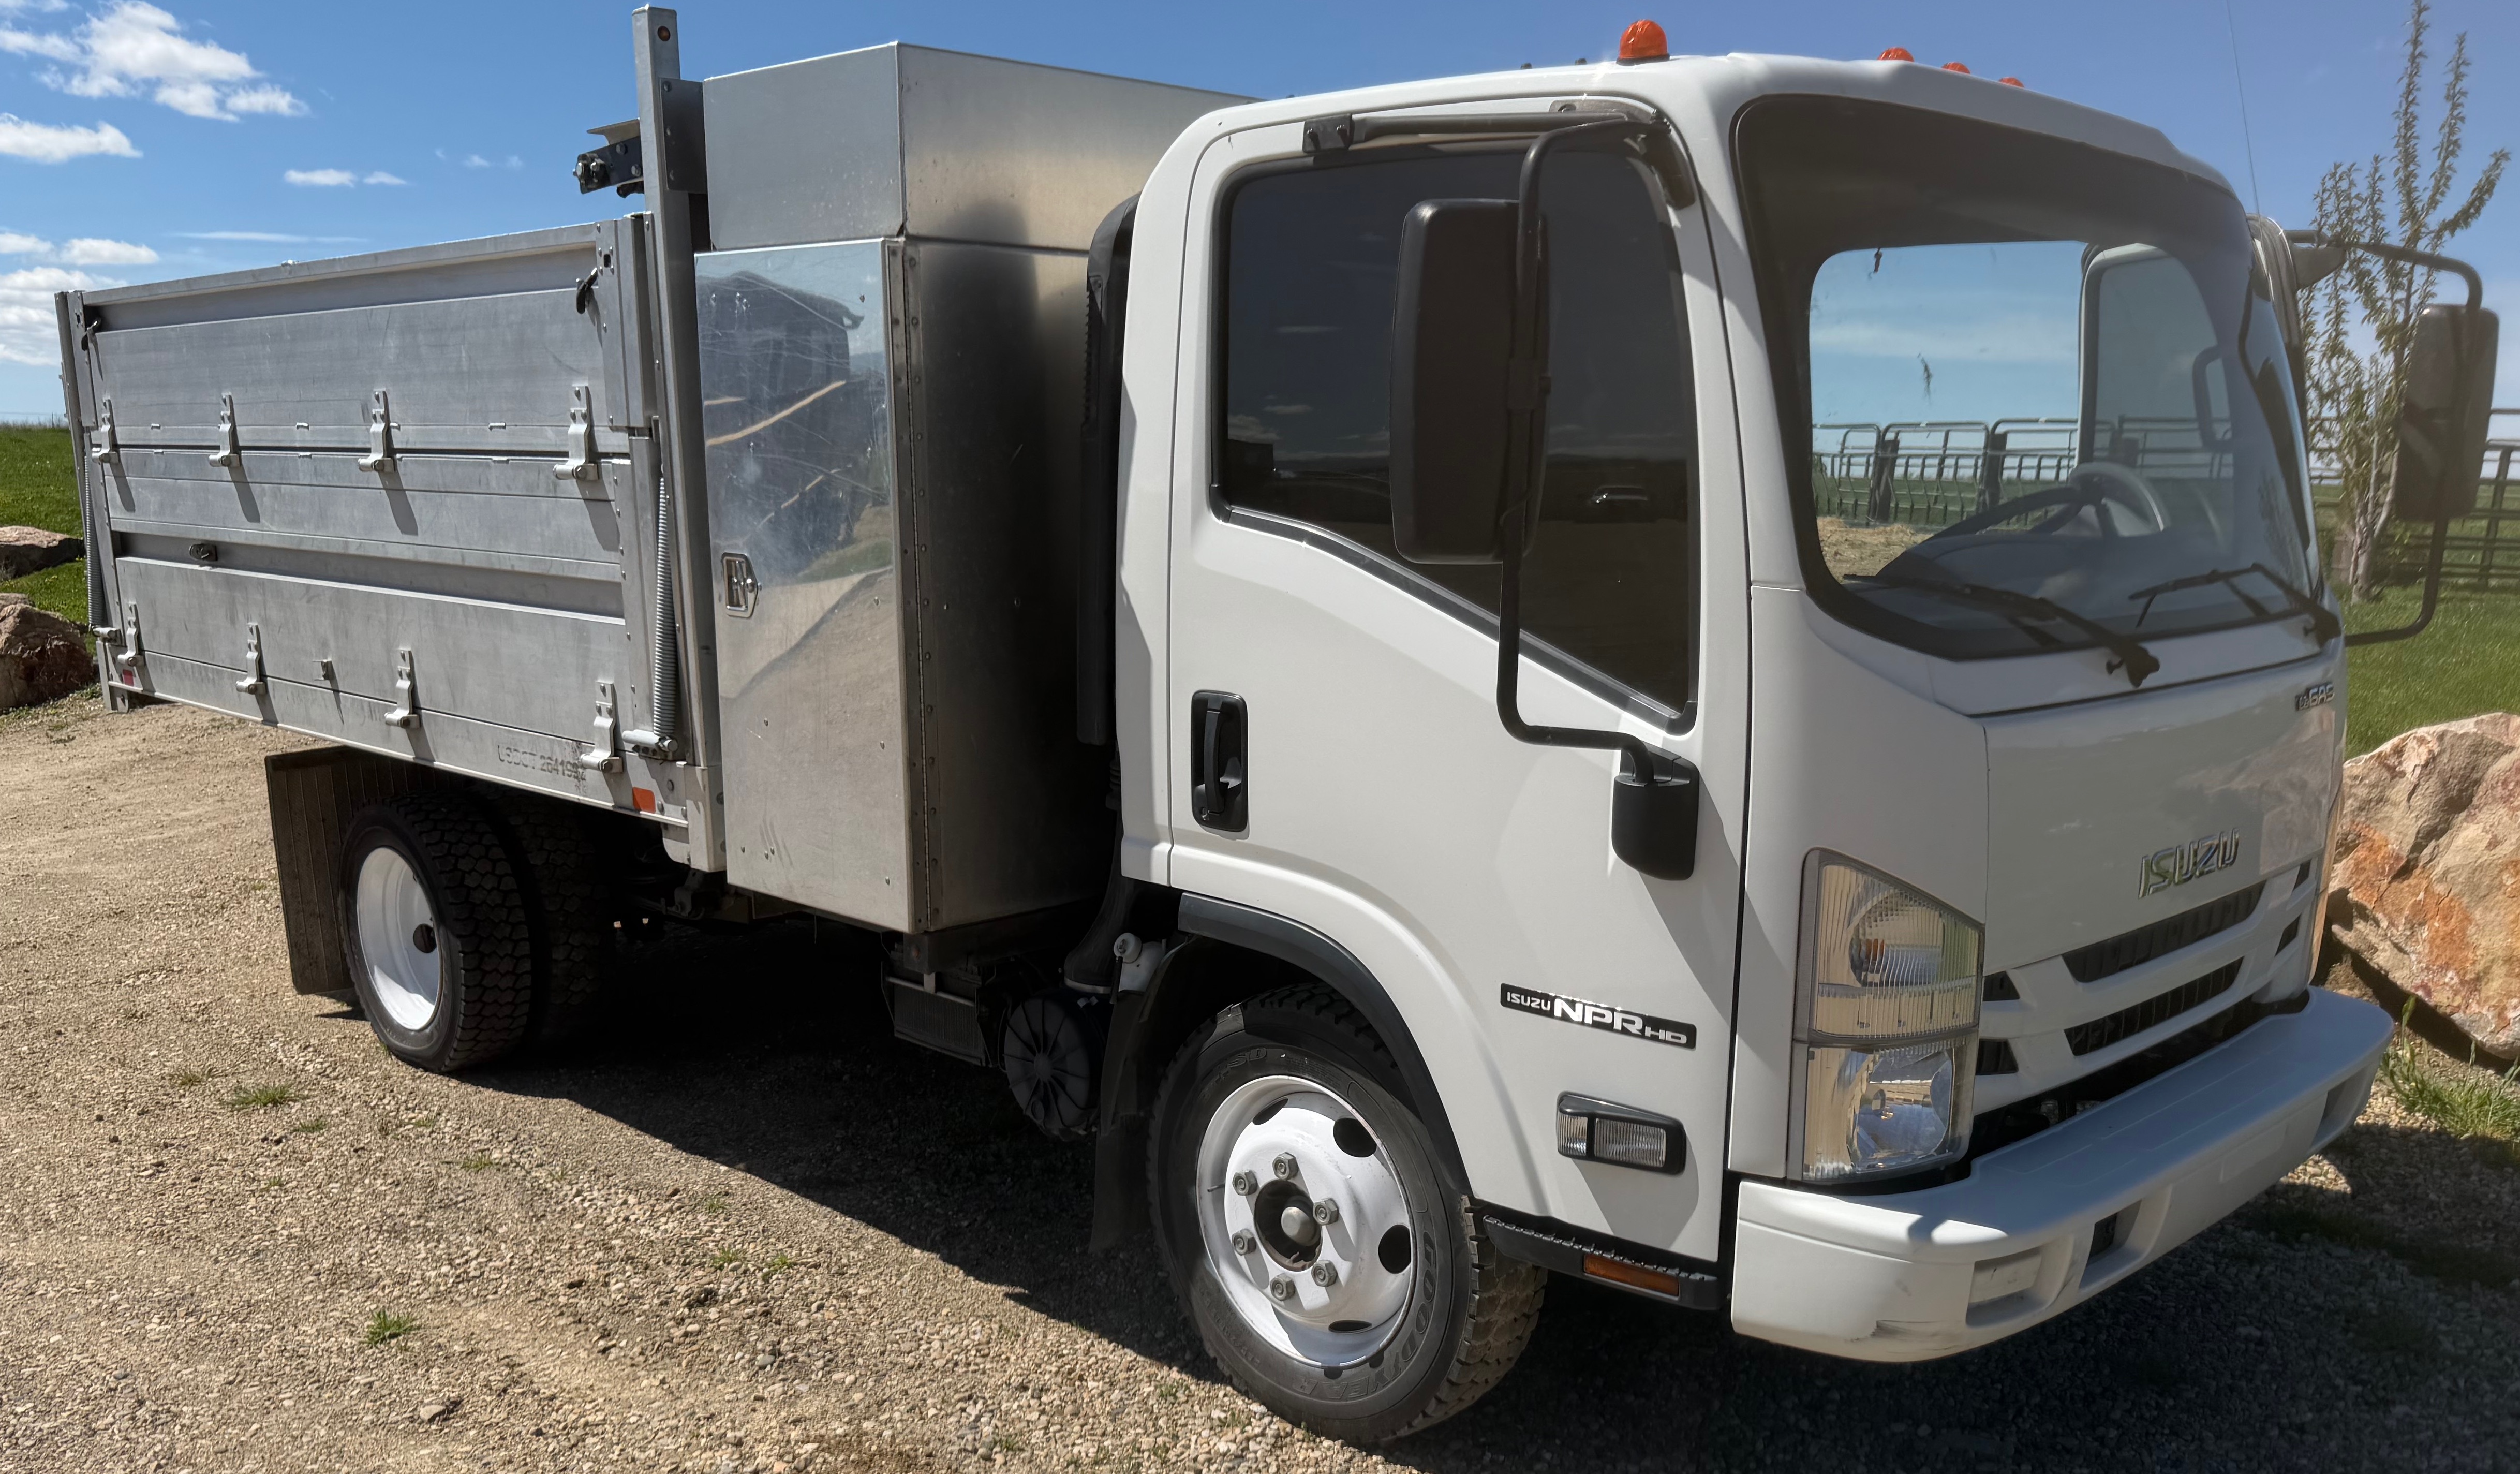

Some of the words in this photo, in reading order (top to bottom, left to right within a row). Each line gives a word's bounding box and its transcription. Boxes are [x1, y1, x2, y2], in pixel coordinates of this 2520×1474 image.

[2138, 827, 2240, 899] ISUZU
[1507, 991, 1551, 1011] ISUZU
[1553, 998, 1644, 1036] NPR
[1644, 1026, 1687, 1044] HD
[1293, 1231, 1438, 1400] GOODYEAR
